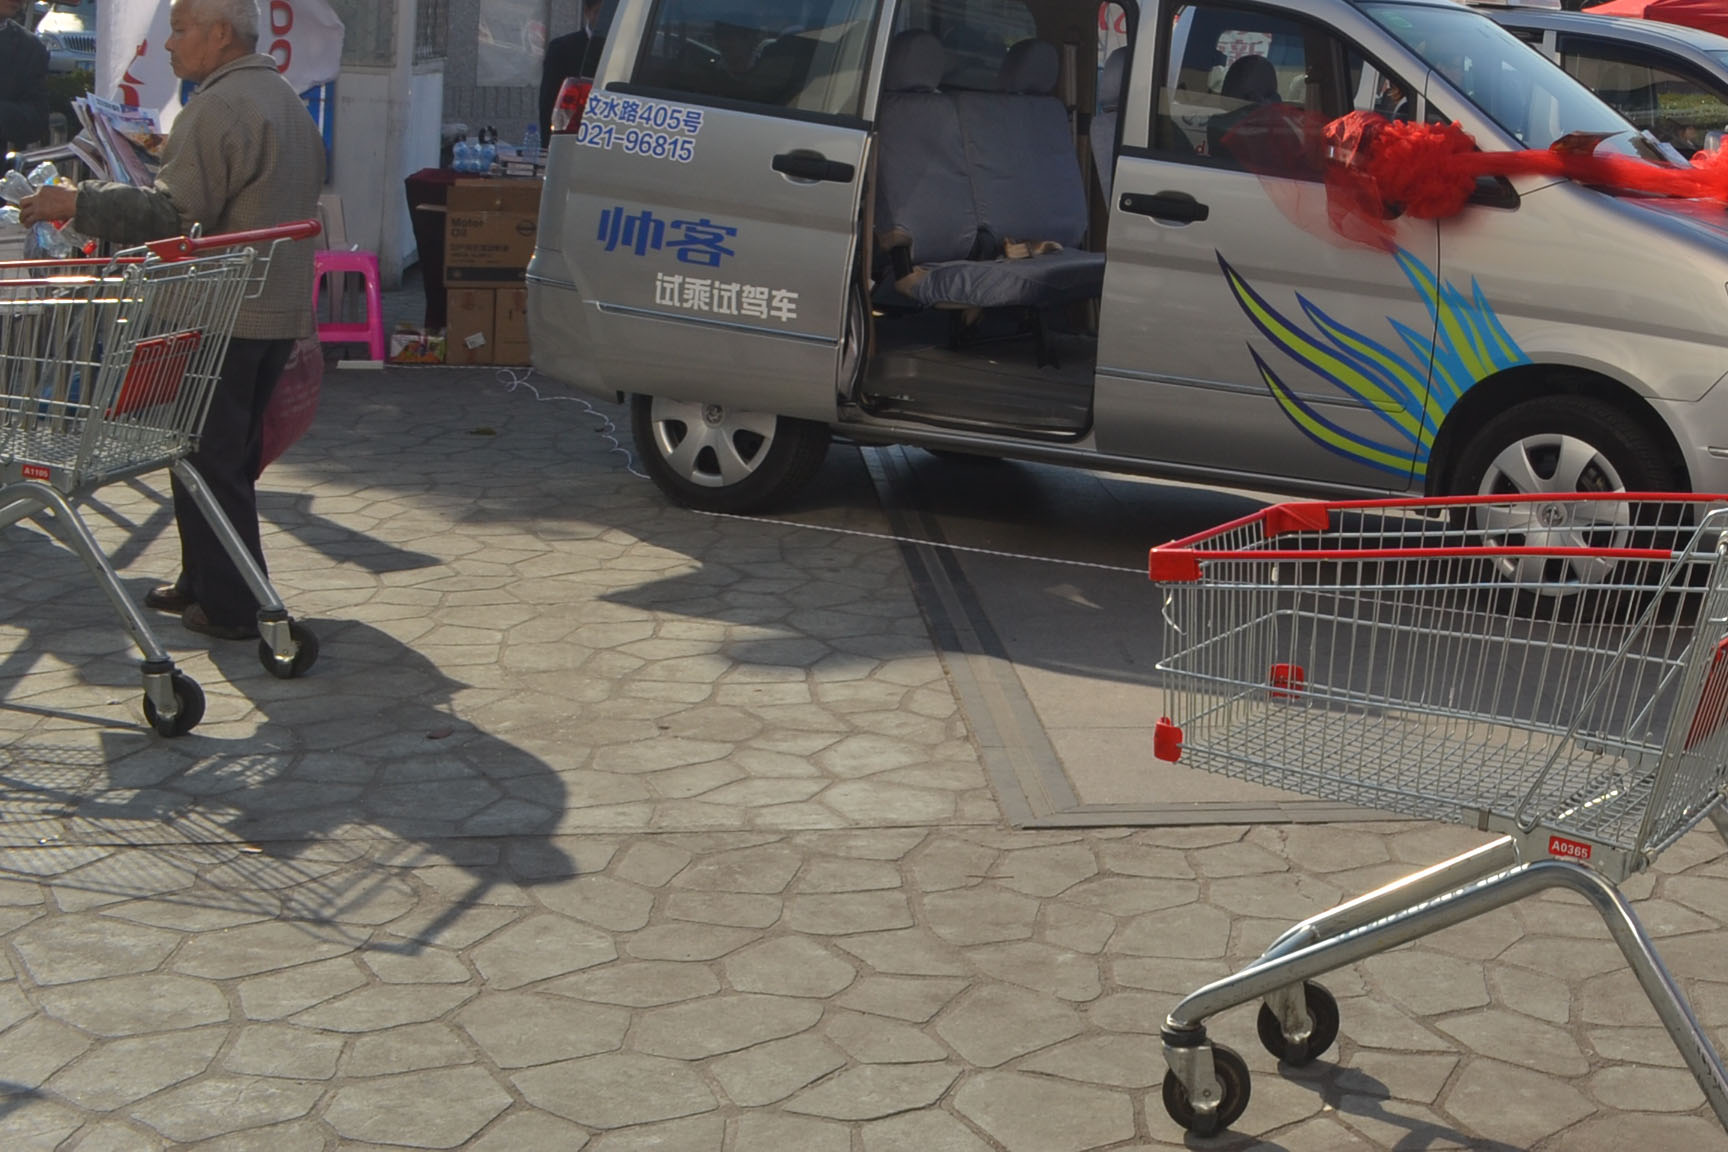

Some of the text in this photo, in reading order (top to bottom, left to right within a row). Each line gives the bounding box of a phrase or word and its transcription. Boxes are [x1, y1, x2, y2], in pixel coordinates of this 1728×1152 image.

[586, 95, 703, 133] 文水路405号
[576, 122, 694, 161] 021-96815
[597, 206, 738, 267] 帅客
[654, 272, 799, 321] 试乘试驾车
[1551, 840, 1589, 858] A0365
